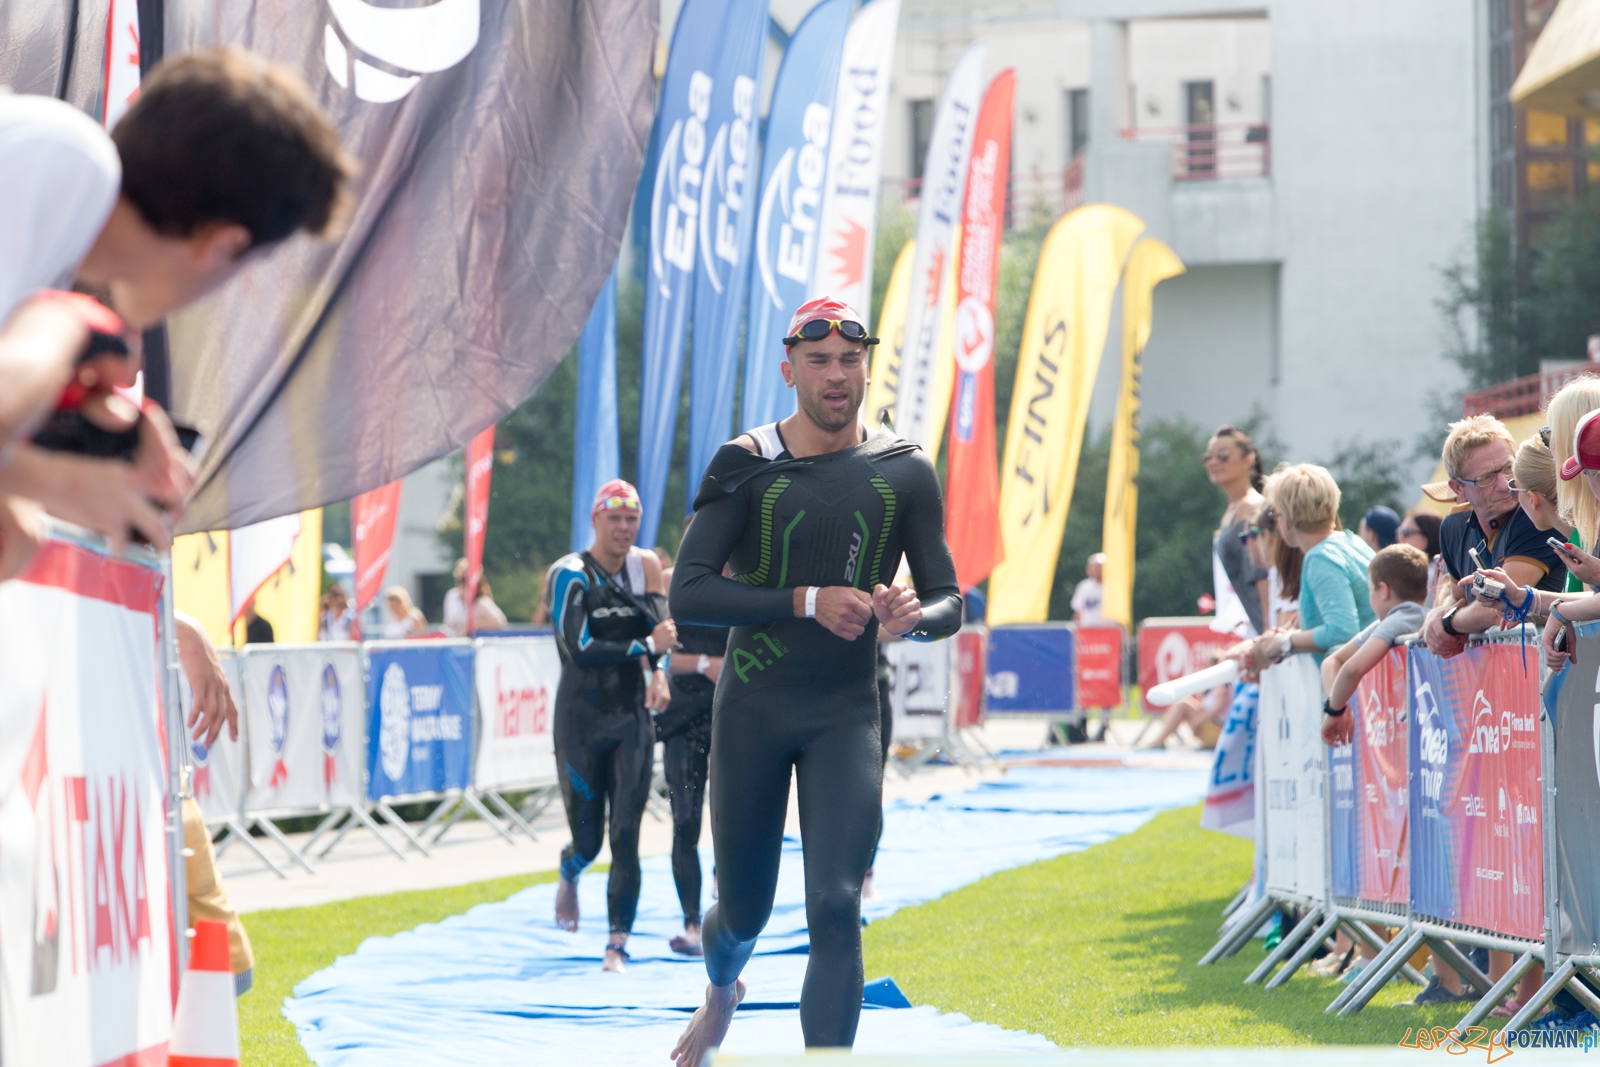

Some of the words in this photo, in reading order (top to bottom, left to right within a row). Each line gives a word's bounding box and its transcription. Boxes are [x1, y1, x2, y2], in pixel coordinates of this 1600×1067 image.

[663, 70, 713, 273] Enea
[776, 101, 832, 285] Enea
[834, 65, 879, 199] Food
[1015, 308, 1068, 485] FINIS
[843, 531, 862, 583] 2XU
